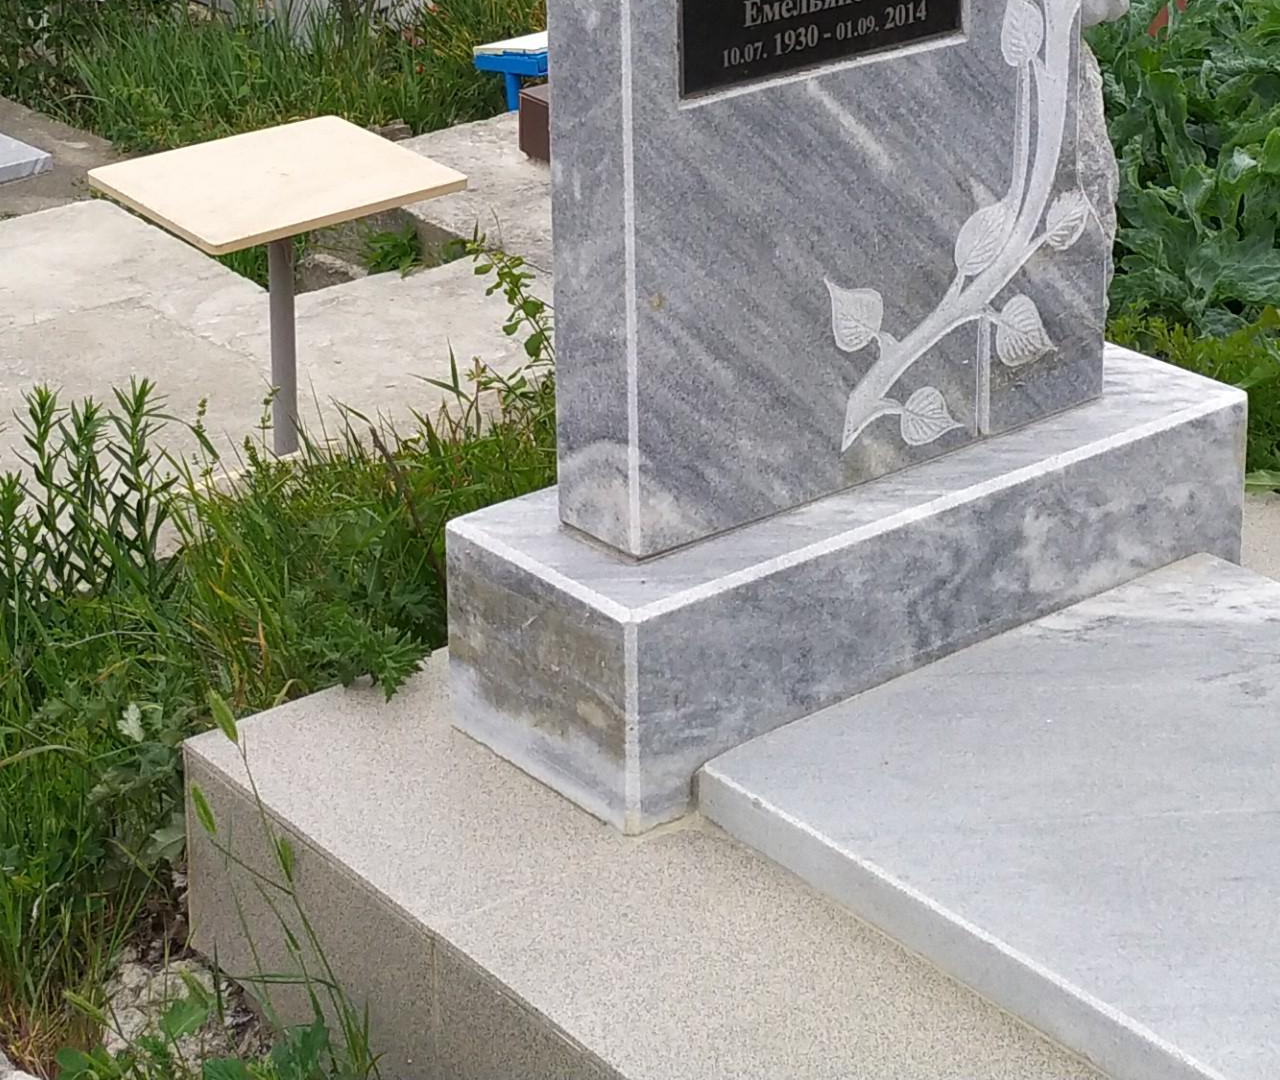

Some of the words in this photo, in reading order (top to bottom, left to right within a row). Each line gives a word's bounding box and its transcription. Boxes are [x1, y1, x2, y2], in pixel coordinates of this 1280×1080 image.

[722, 41, 767, 68] 10.07.
[774, 24, 818, 56] 1930
[836, 15, 879, 41] 01.09.
